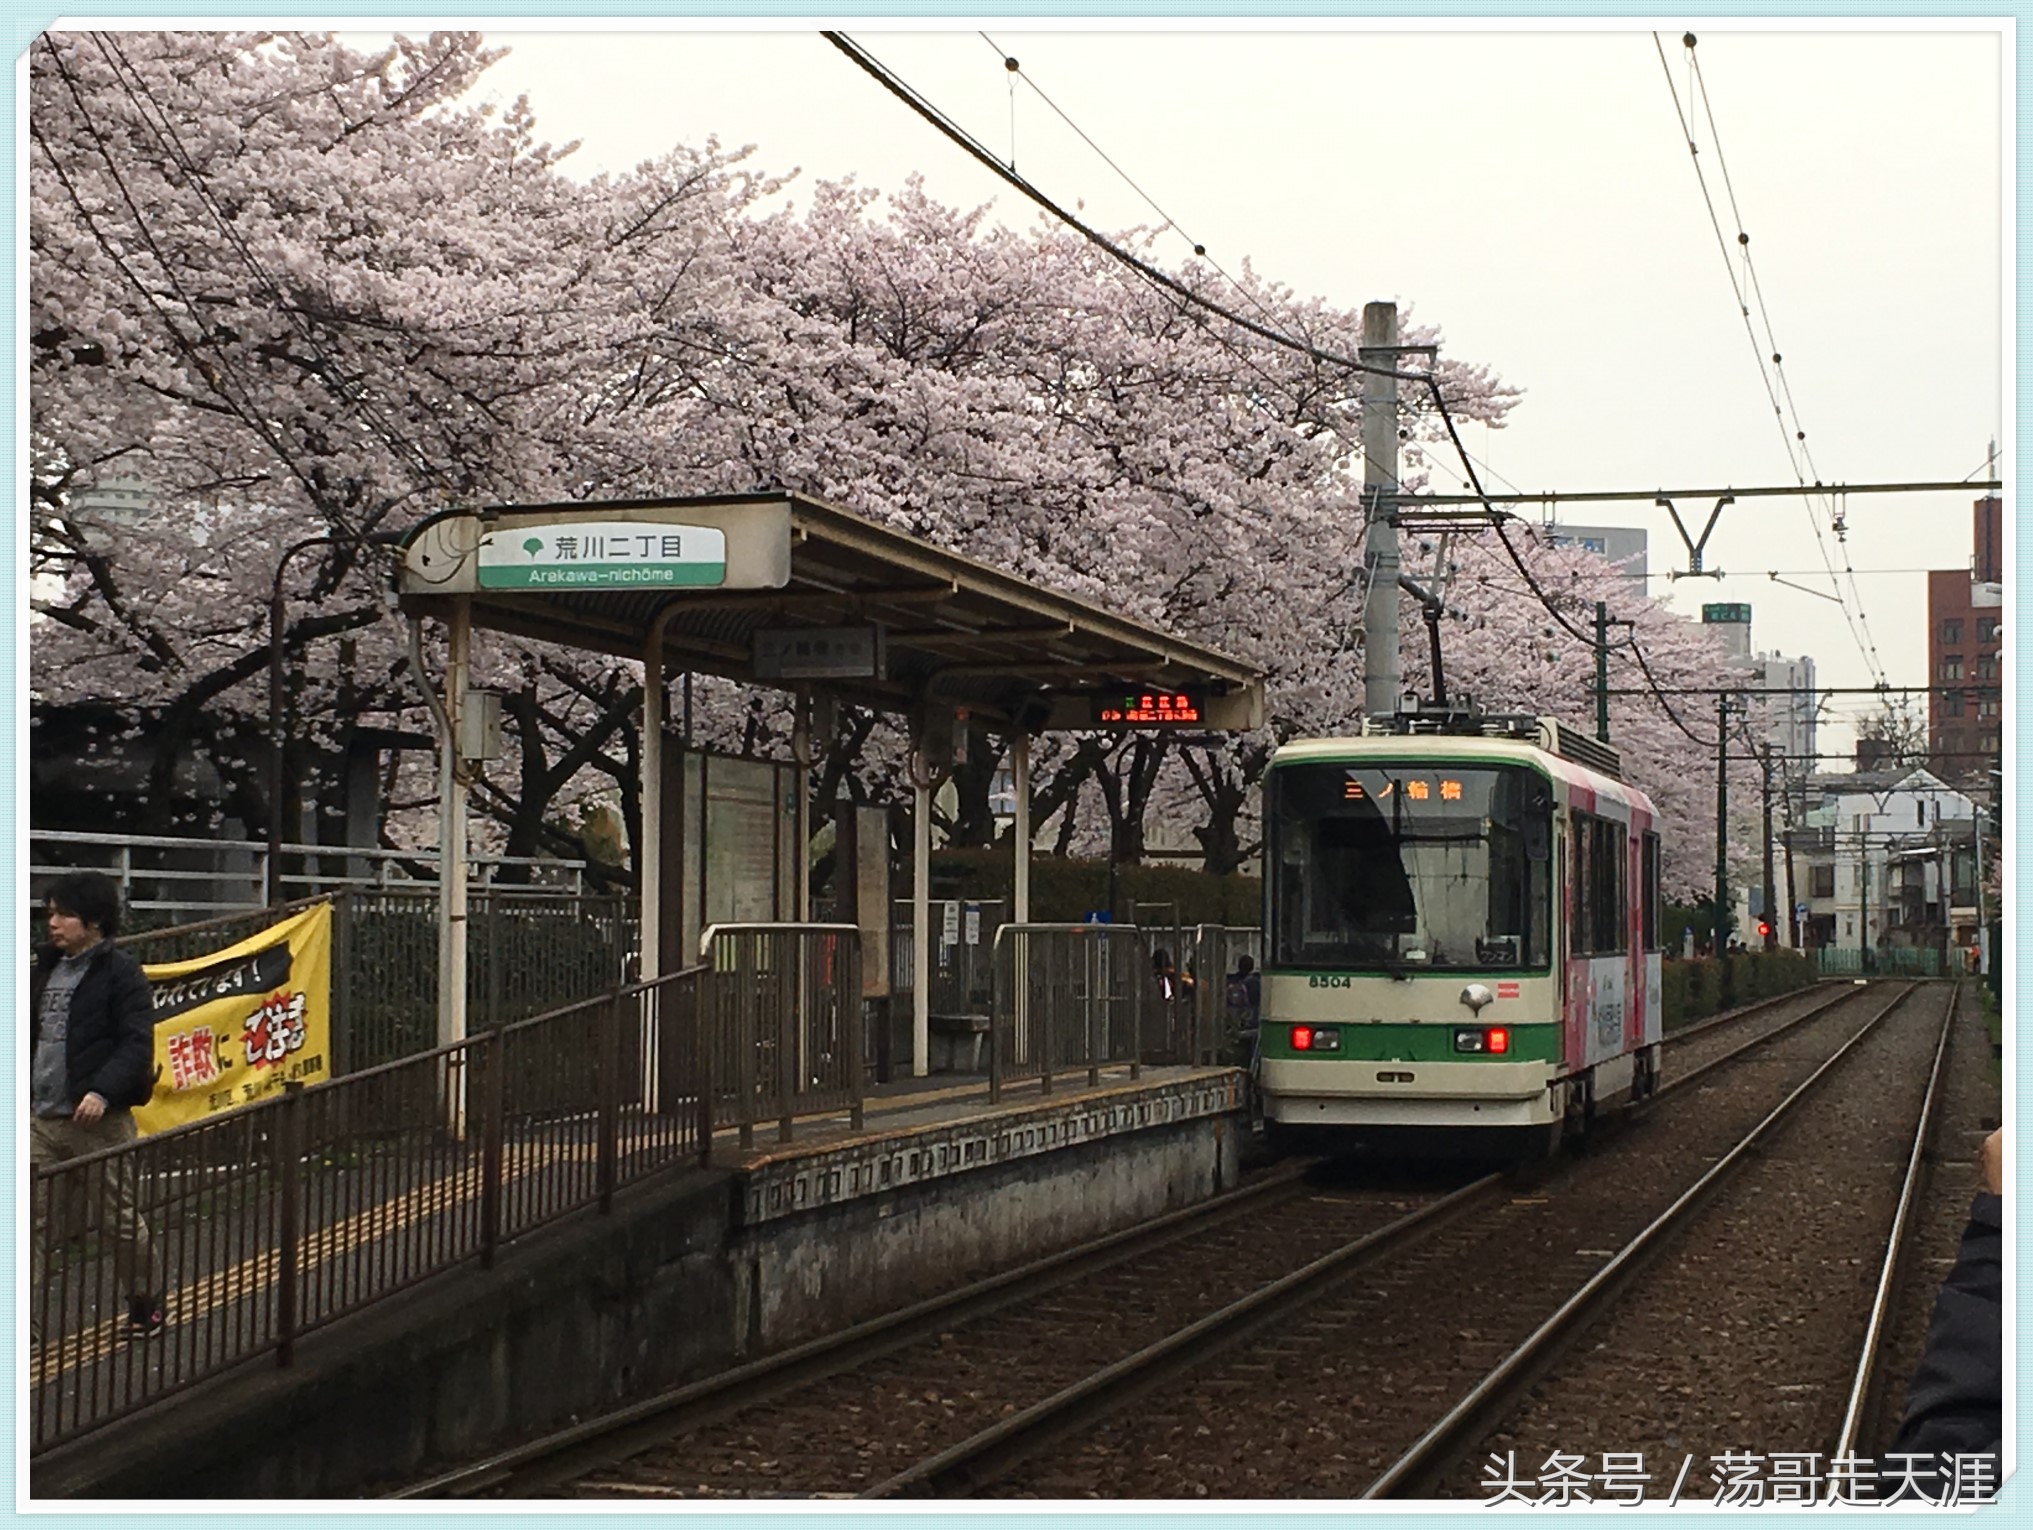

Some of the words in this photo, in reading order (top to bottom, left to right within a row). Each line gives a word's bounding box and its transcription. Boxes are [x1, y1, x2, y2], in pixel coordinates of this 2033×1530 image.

[555, 535, 682, 560] 荒川二丁目
[1308, 975, 1352, 989] 8504
